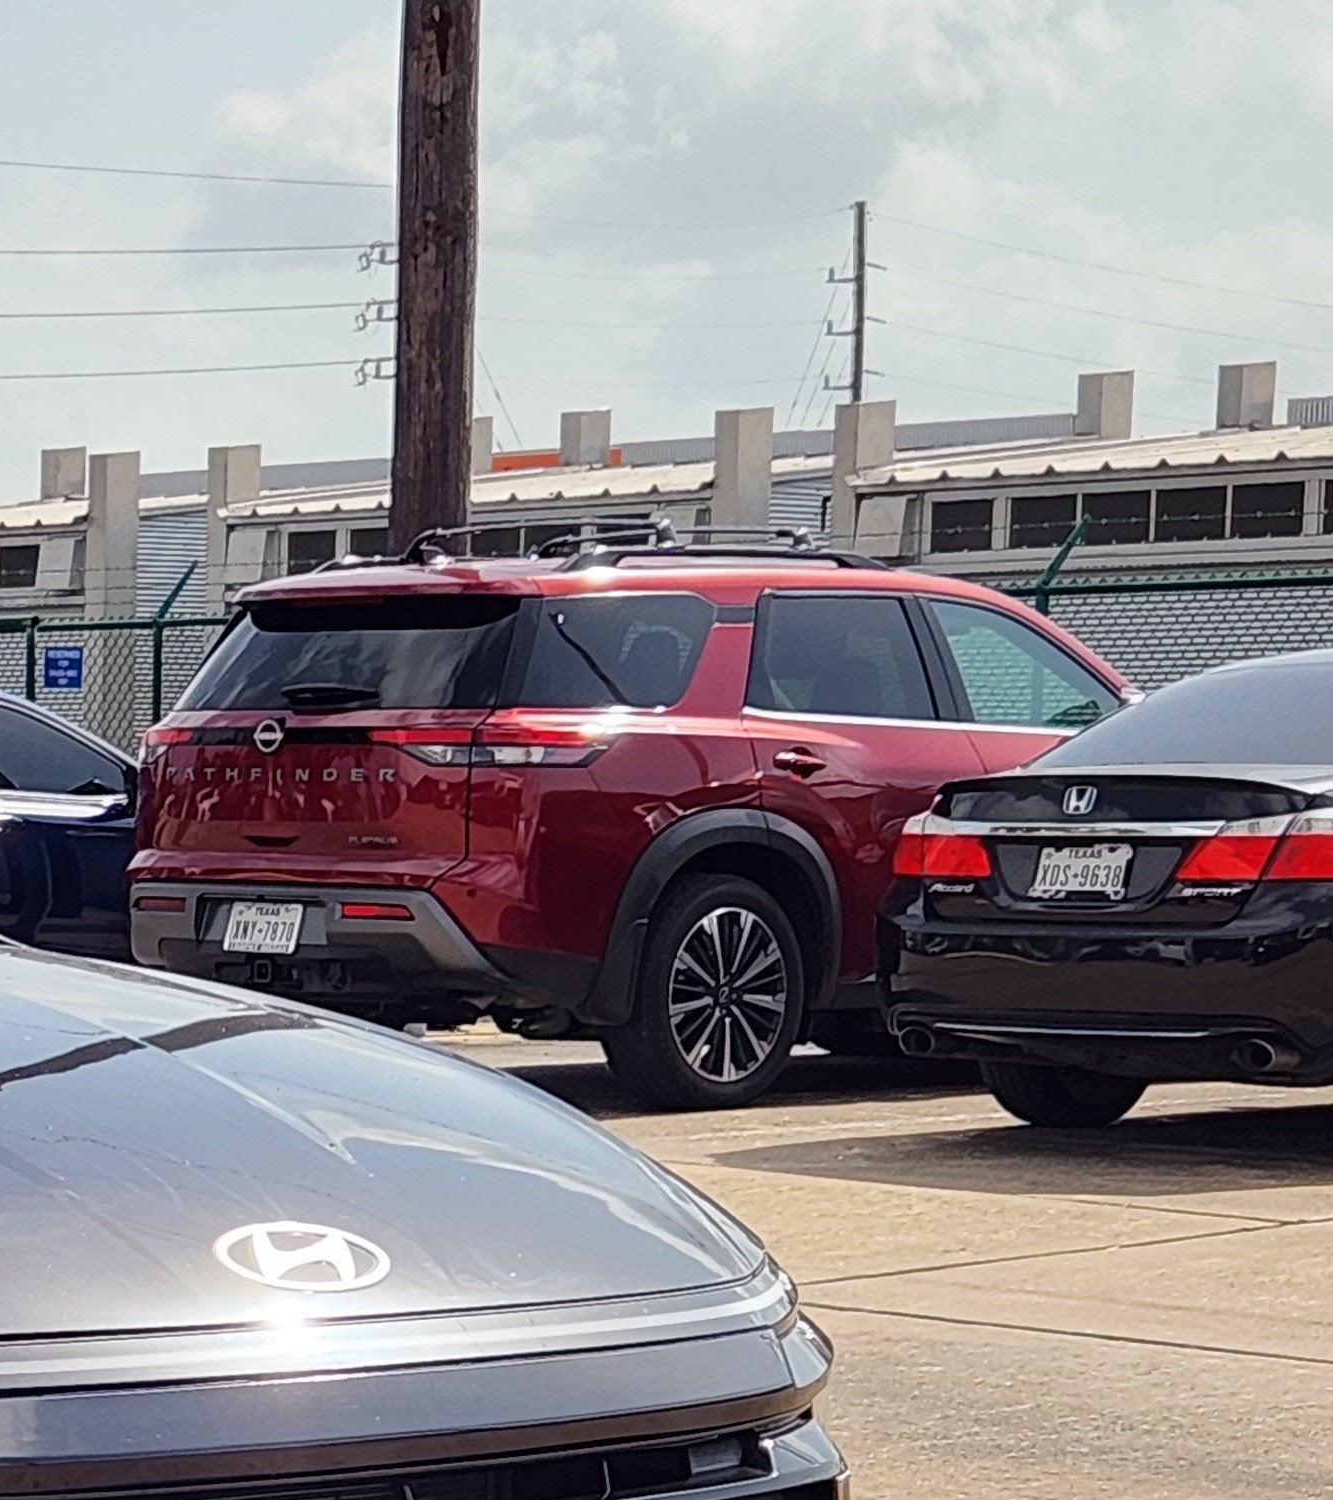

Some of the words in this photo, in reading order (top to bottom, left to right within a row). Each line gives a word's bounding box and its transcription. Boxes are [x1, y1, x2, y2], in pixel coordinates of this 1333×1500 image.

[165, 766, 397, 784] PATHFINDER
[1068, 848, 1103, 860] TEXAS
[255, 906, 281, 917] TEXAS
